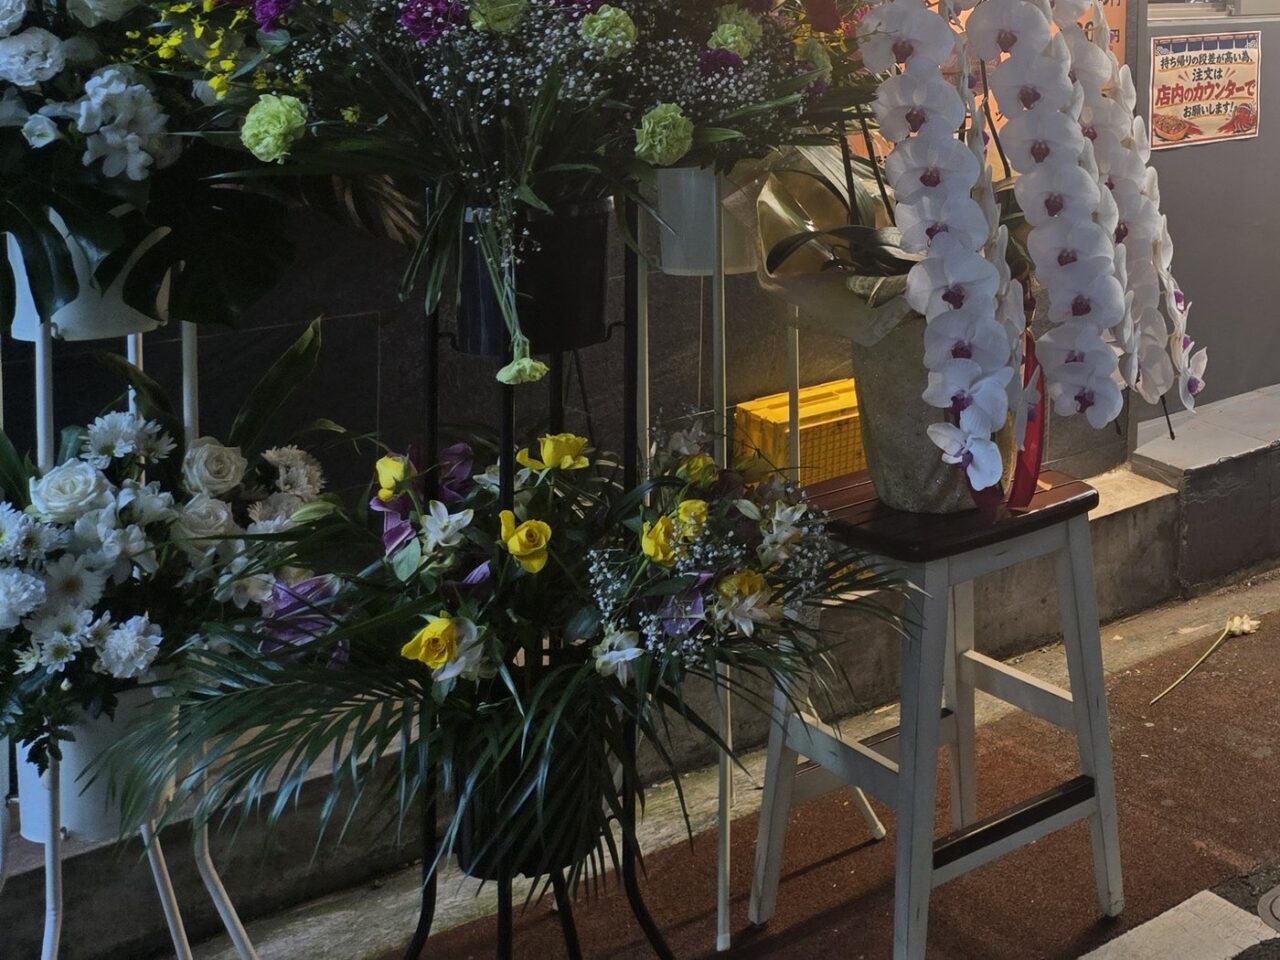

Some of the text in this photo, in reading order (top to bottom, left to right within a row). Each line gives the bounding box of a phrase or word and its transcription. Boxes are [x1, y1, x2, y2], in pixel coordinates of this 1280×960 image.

[1192, 67, 1223, 82] 注文は
[1155, 79, 1256, 106] 店内のカウンターで
[1183, 101, 1235, 118] お願いします!
